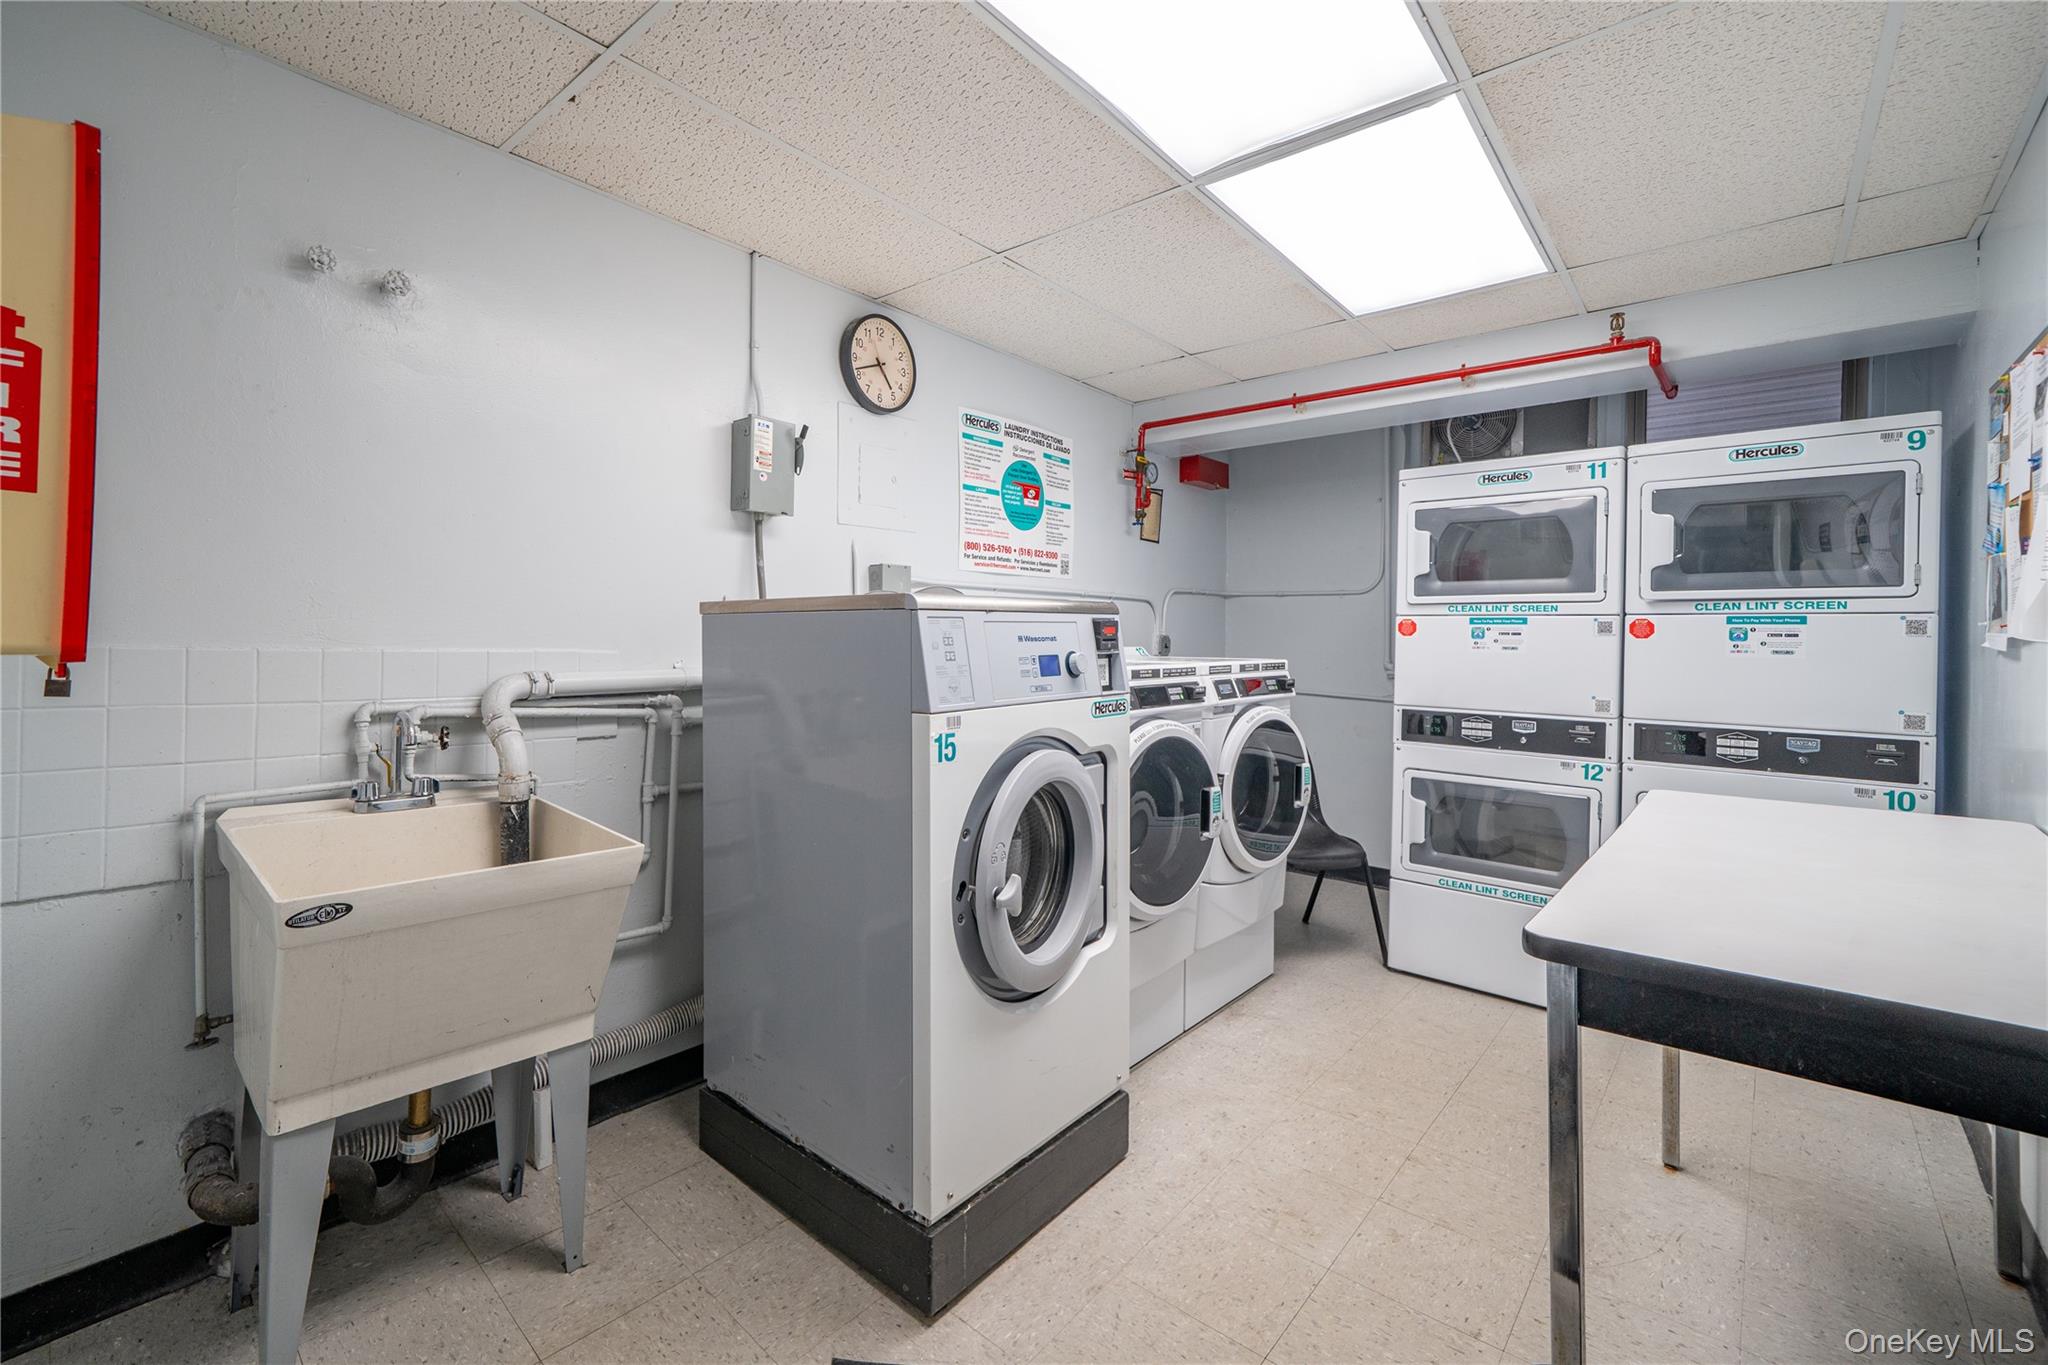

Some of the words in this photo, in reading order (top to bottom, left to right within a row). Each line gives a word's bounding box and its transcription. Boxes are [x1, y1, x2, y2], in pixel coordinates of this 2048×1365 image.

[864, 328, 871, 339] 11
[875, 326, 885, 338] 12
[855, 337, 863, 348] 10
[891, 338, 895, 346] 1
[852, 352, 857, 362] 9
[898, 351, 904, 361] 2
[856, 370, 861, 380] 8
[900, 367, 906, 377] 3
[865, 384, 870, 393] 7
[898, 383, 902, 392] 4
[877, 393, 882, 403] 6
[890, 391, 896, 401] 5
[965, 413, 999, 432] Hercules
[1004, 422, 1030, 435] LAUNDRY
[1030, 429, 1064, 446] INSTRUCTIONS
[1003, 430, 1045, 447] INSTRUCCIONES
[1046, 441, 1052, 449] DE
[1053, 444, 1071, 455] LAVADO
[1907, 430, 1926, 450] 9
[1735, 444, 1799, 460] Hercules
[1587, 462, 1606, 479] 11
[1482, 471, 1529, 485] Hercules
[964, 541, 981, 552] (800)
[971, 553, 987, 561] Service
[1448, 605, 1484, 613] CLEAN
[1486, 604, 1509, 613] LINT
[1512, 604, 1559, 613] SCREEN
[1694, 602, 1741, 612] CLEAN
[1746, 601, 1780, 611] LINT
[1783, 601, 1848, 611] SCREEN
[1094, 700, 1127, 715] Hercules
[934, 732, 957, 763] 15
[1581, 763, 1604, 781] 12
[1883, 790, 1916, 812] 10
[1438, 877, 1472, 891] CLEAN
[1475, 885, 1499, 896] LINT
[1502, 889, 1548, 906] SCREEN
